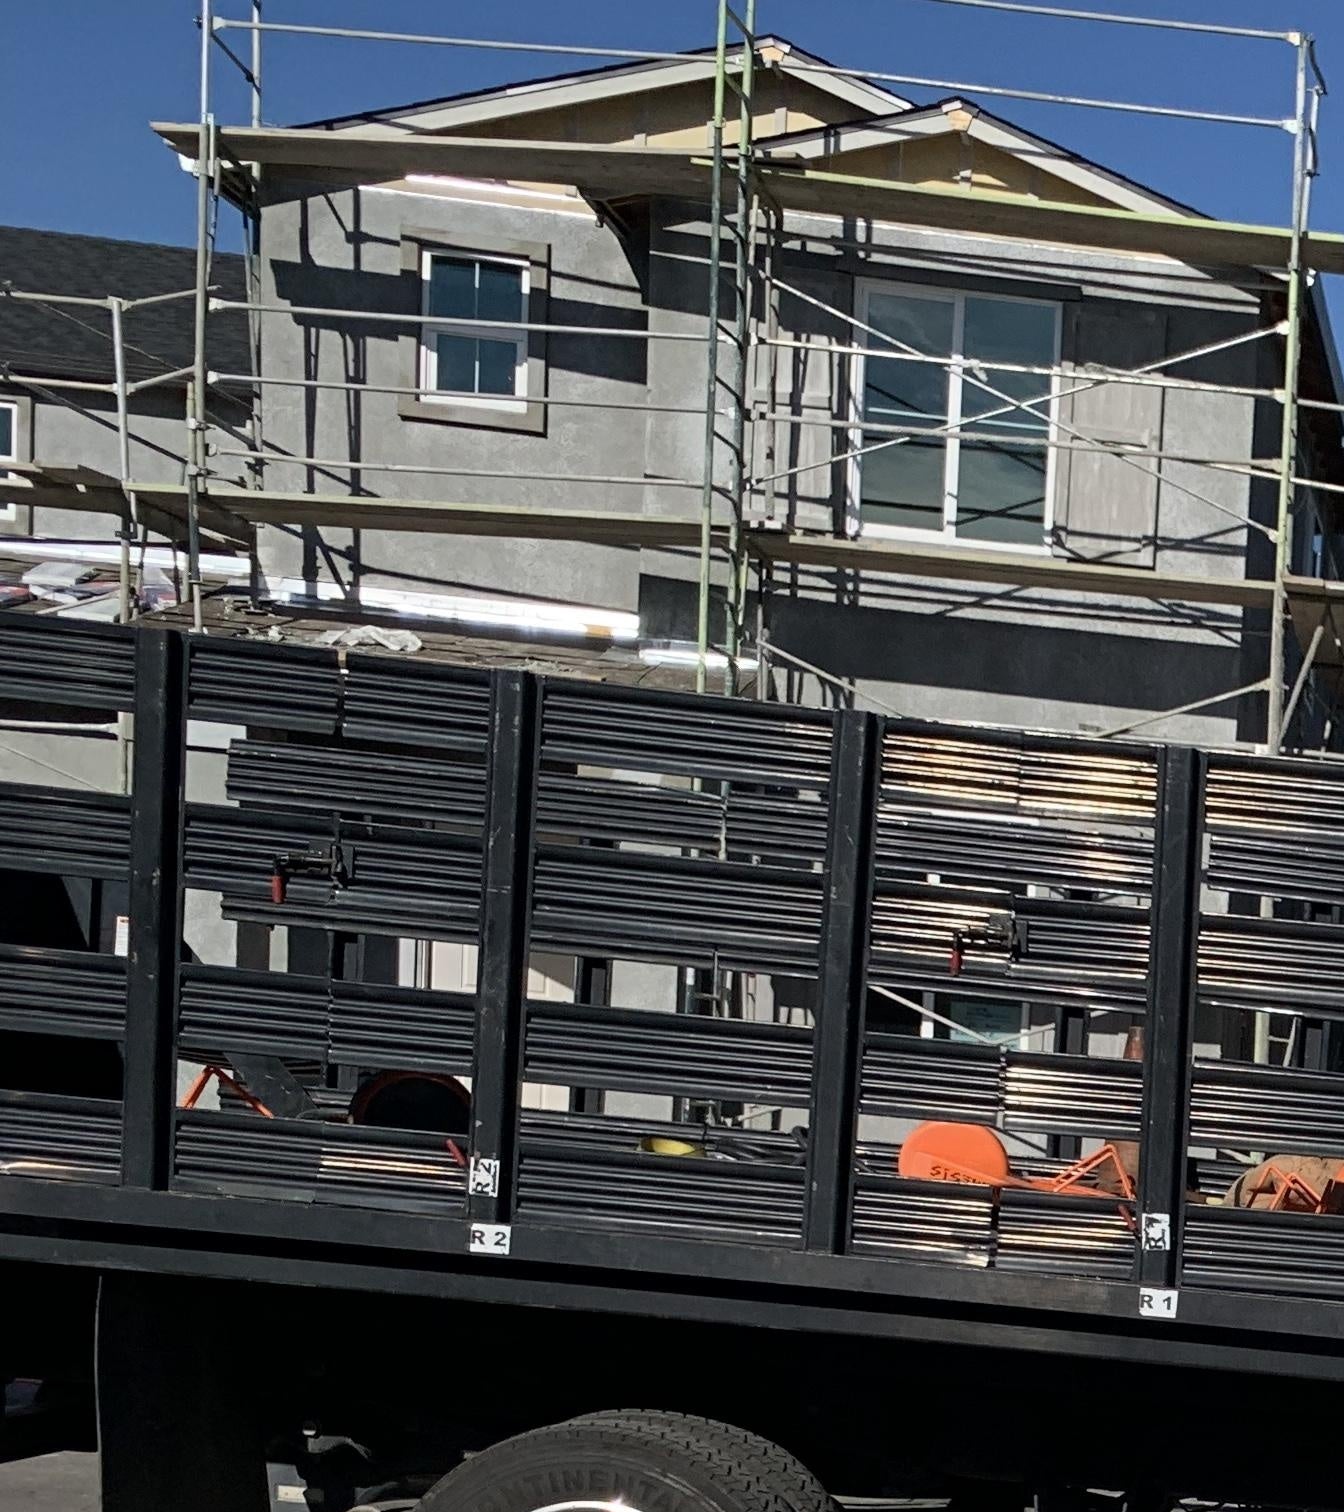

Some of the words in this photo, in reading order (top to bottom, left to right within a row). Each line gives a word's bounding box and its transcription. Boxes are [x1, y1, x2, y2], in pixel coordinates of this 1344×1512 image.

[471, 1229, 486, 1245] R
[494, 1231, 507, 1247] 2
[1140, 1294, 1154, 1309] R
[1163, 1296, 1172, 1311] 1
